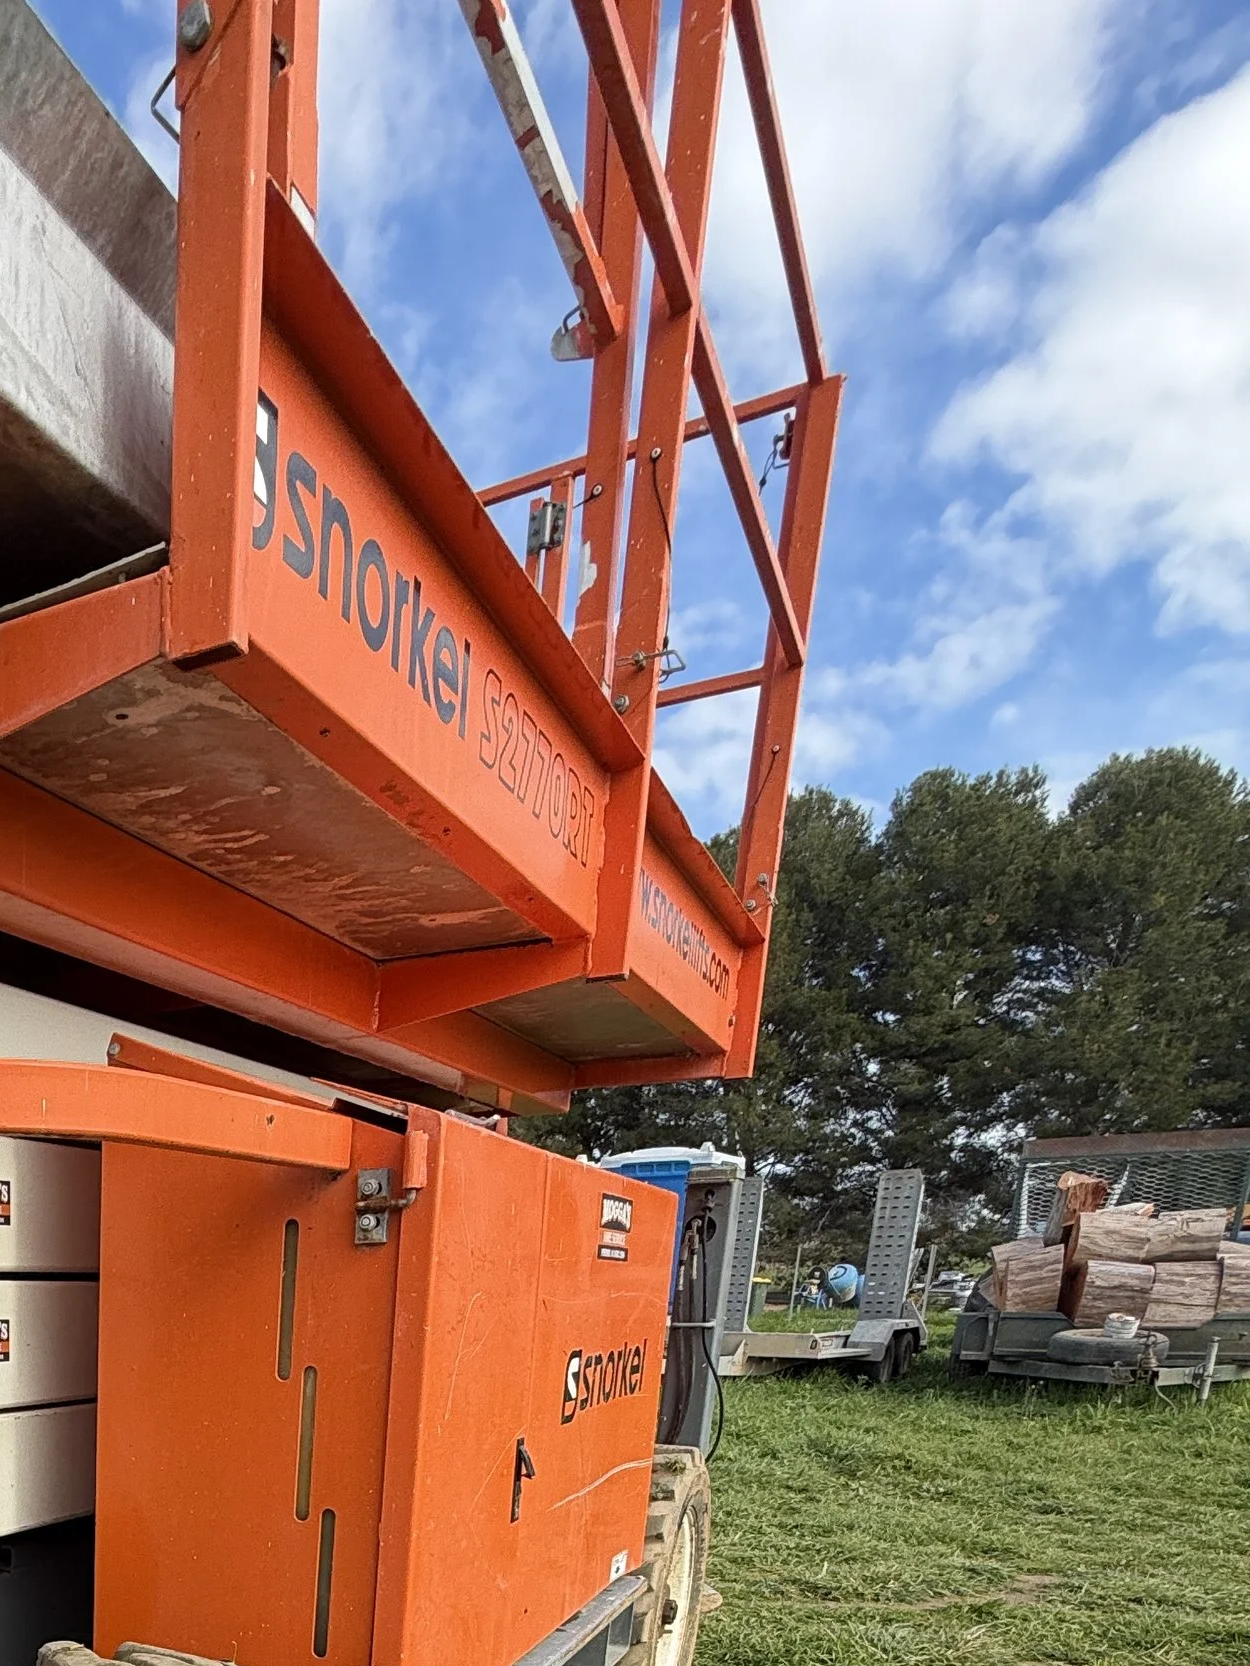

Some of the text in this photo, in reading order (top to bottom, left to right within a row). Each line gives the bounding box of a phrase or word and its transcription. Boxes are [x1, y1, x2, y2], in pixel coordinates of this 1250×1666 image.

[282, 450, 471, 741] snorkel
[479, 667, 595, 868] S2770RT
[579, 1338, 648, 1411] snorkel
